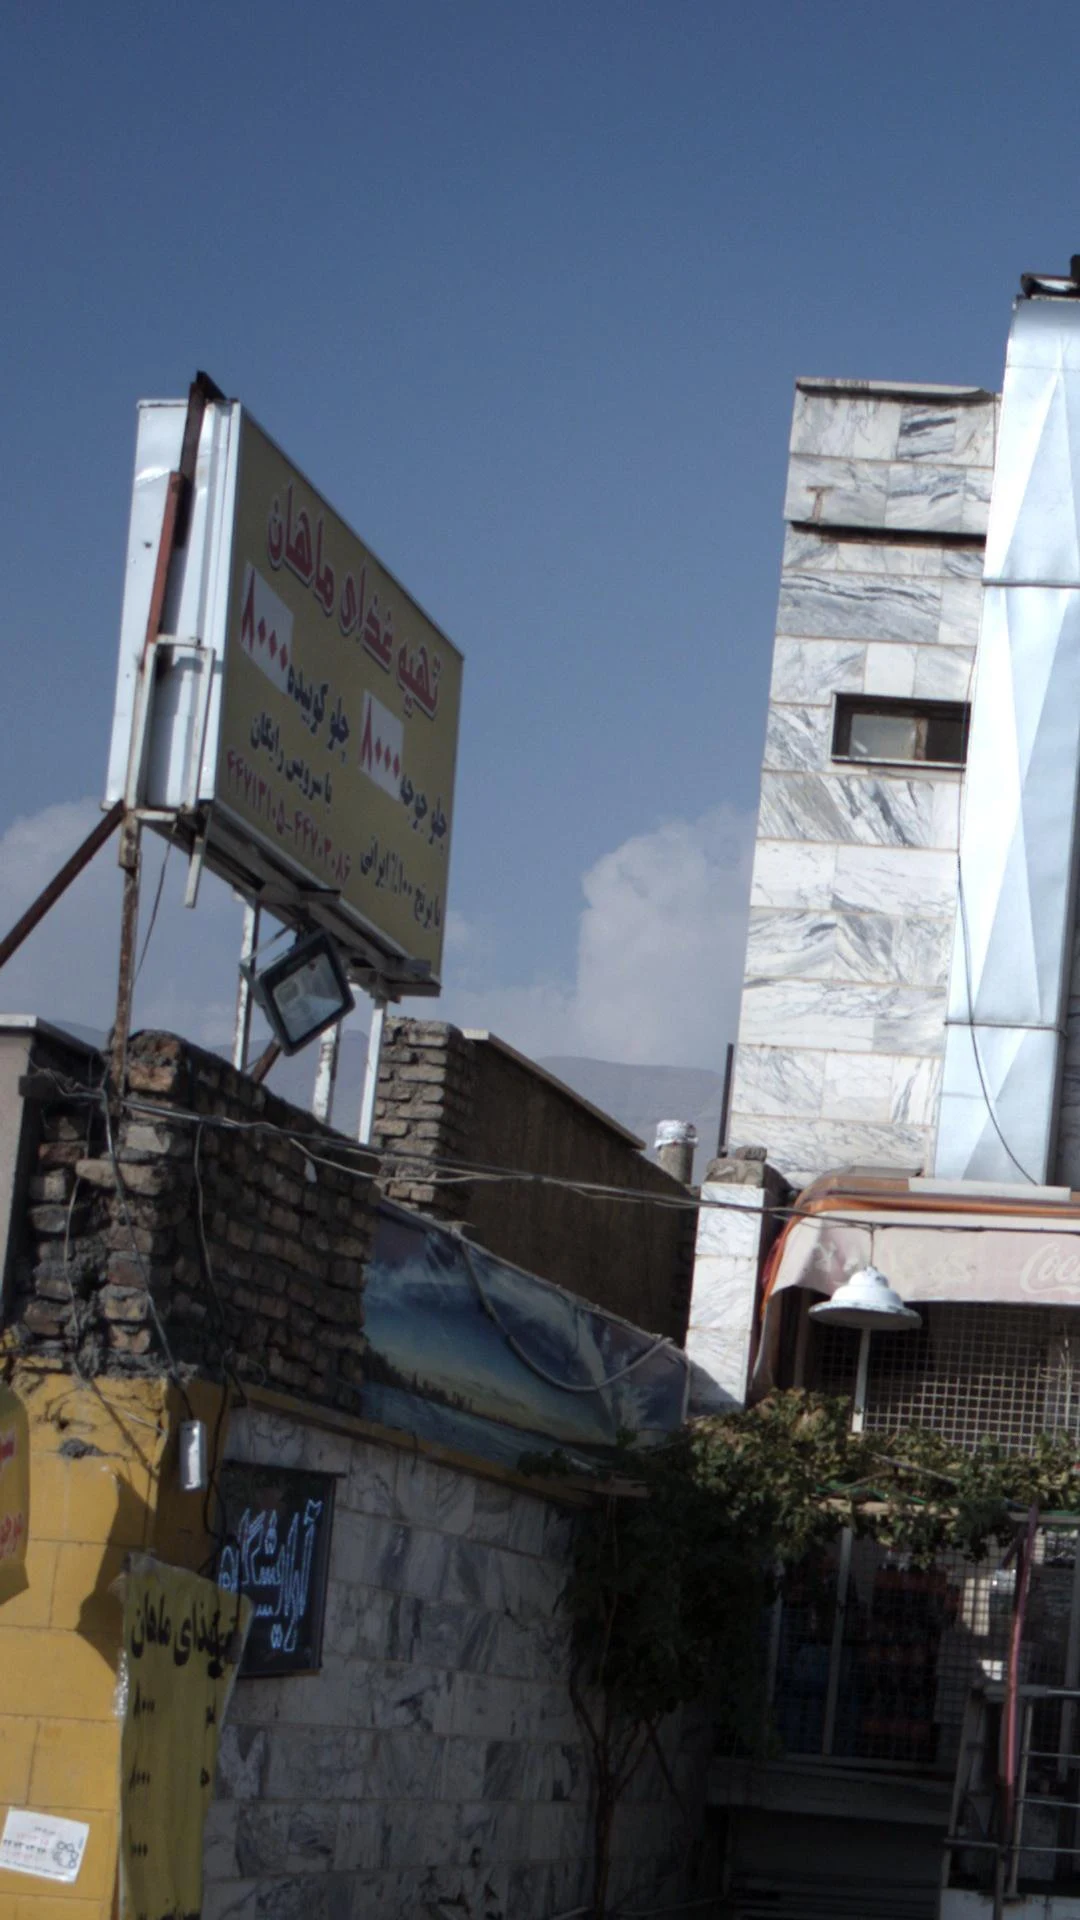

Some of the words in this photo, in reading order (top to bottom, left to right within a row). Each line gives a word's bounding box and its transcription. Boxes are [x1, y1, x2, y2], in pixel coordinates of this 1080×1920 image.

[267, 478, 335, 617] ماهان
[241, 567, 288, 672] ۸۰۰۰
[338, 560, 393, 673] غذای
[397, 643, 441, 719] تهیه
[327, 696, 350, 763] چلو
[361, 698, 400, 780] ۸۰۰۰
[400, 773, 428, 834] جوجه
[428, 796, 447, 857] چلو
[1020, 1240, 1080, 1294] Coc
[131, 1591, 171, 1659] ماهان
